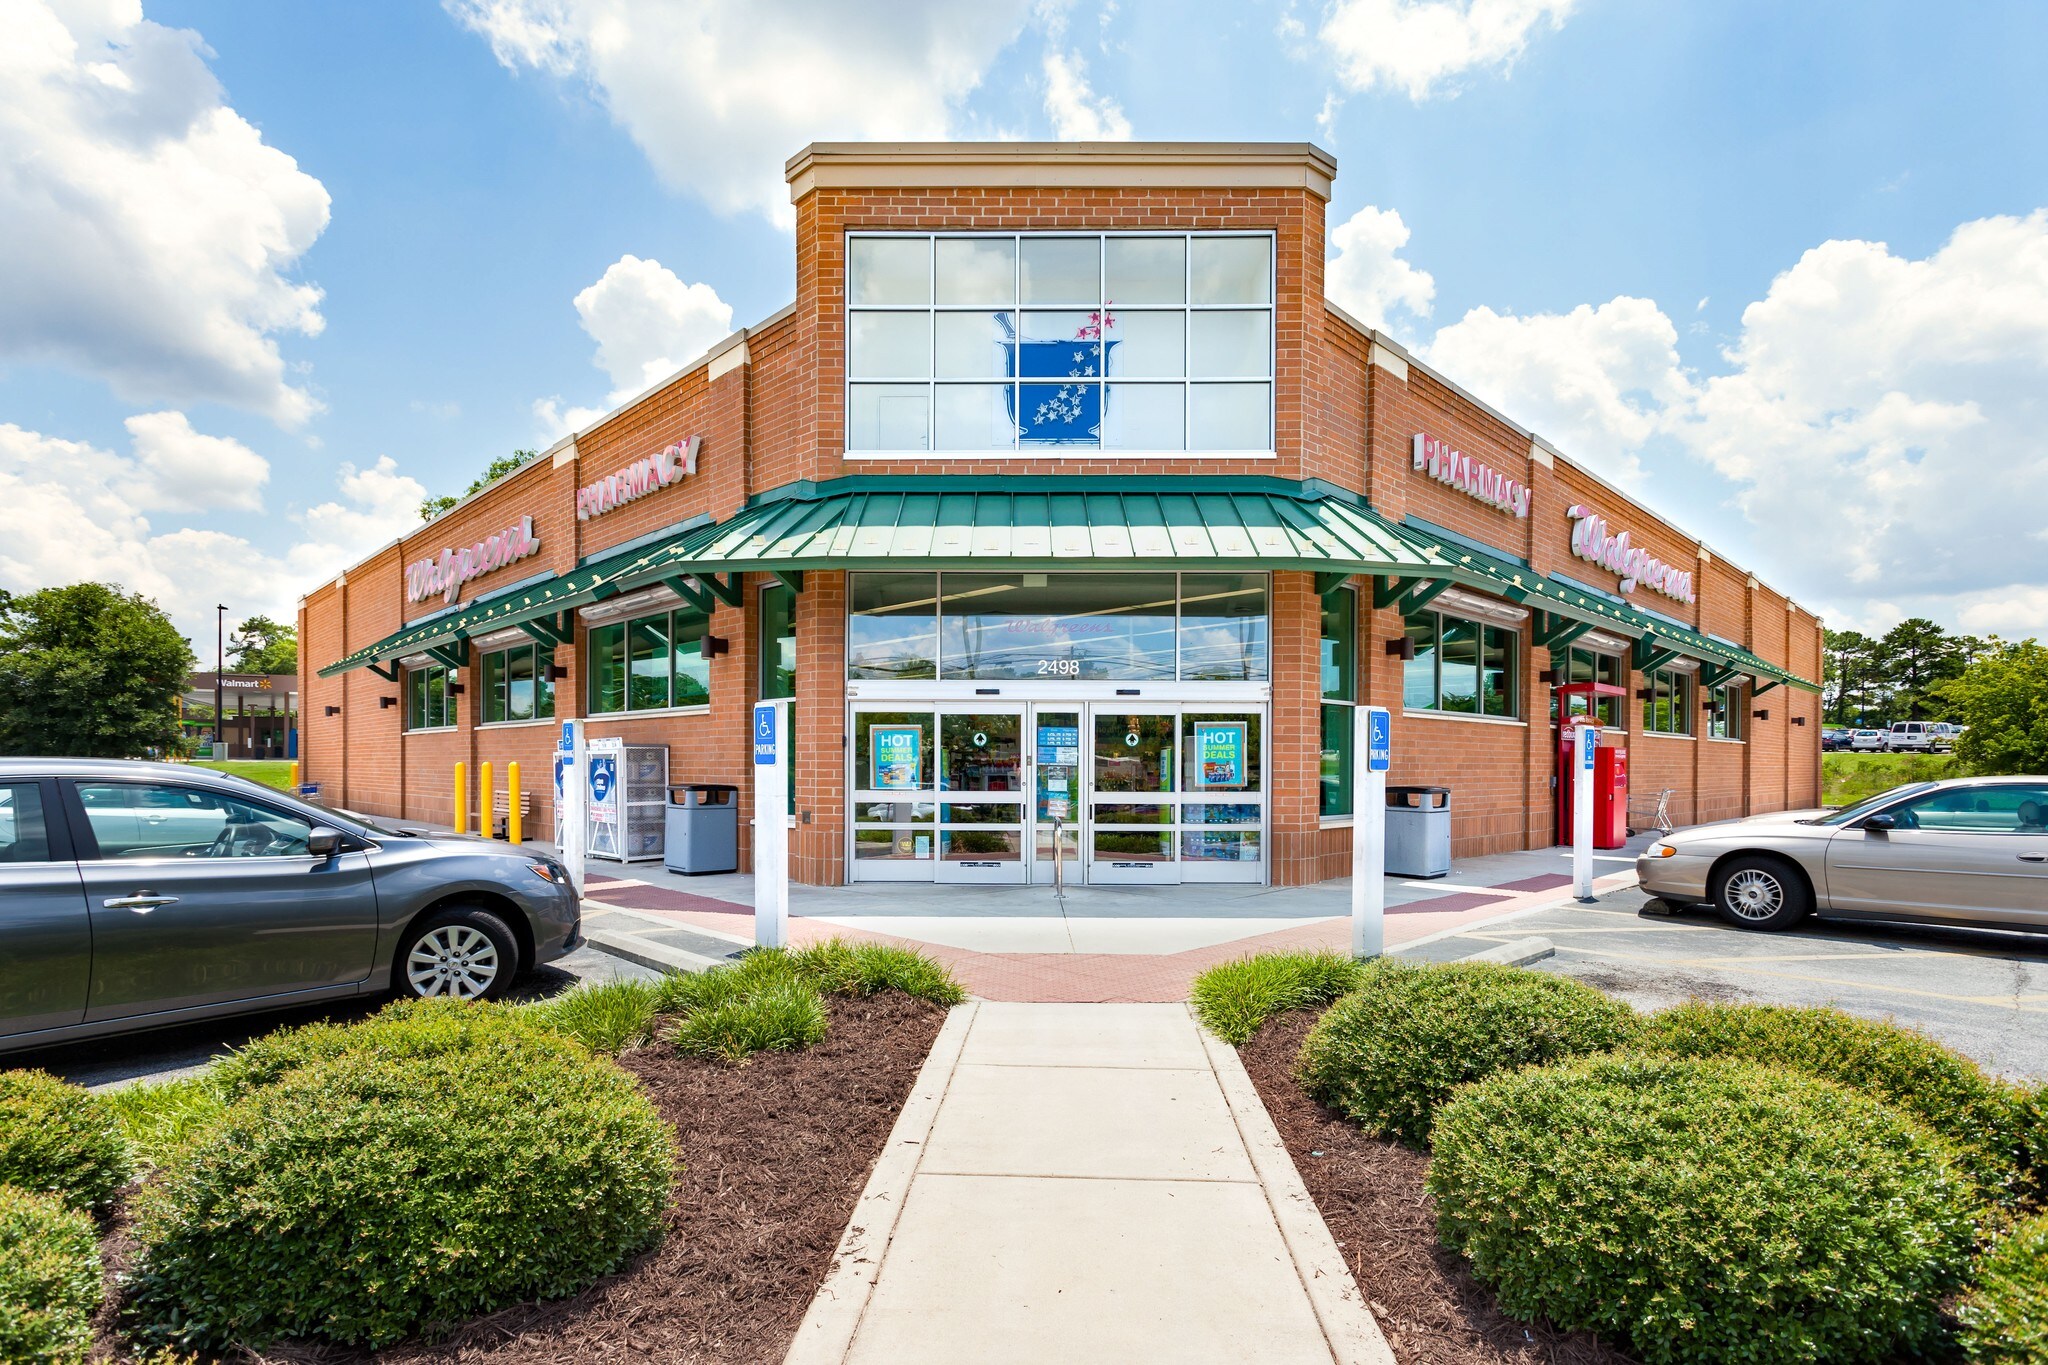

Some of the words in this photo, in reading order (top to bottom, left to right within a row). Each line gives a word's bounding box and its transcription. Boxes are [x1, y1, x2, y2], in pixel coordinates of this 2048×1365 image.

[576, 435, 700, 520] PHARMACY
[1413, 432, 1532, 518] PHARMACY
[405, 515, 540, 604] Walgreens
[1566, 504, 1696, 604] Walgreens
[1005, 619, 1115, 637] Walgreens
[1037, 659, 1080, 675] 2498
[216, 679, 259, 688] Walmart
[881, 734, 913, 747] HOT
[1203, 731, 1236, 744] HOT
[755, 743, 776, 755] PARKING
[1203, 751, 1236, 759] DEALS
[1370, 749, 1389, 760] PARKING
[881, 754, 913, 762] DEALS
